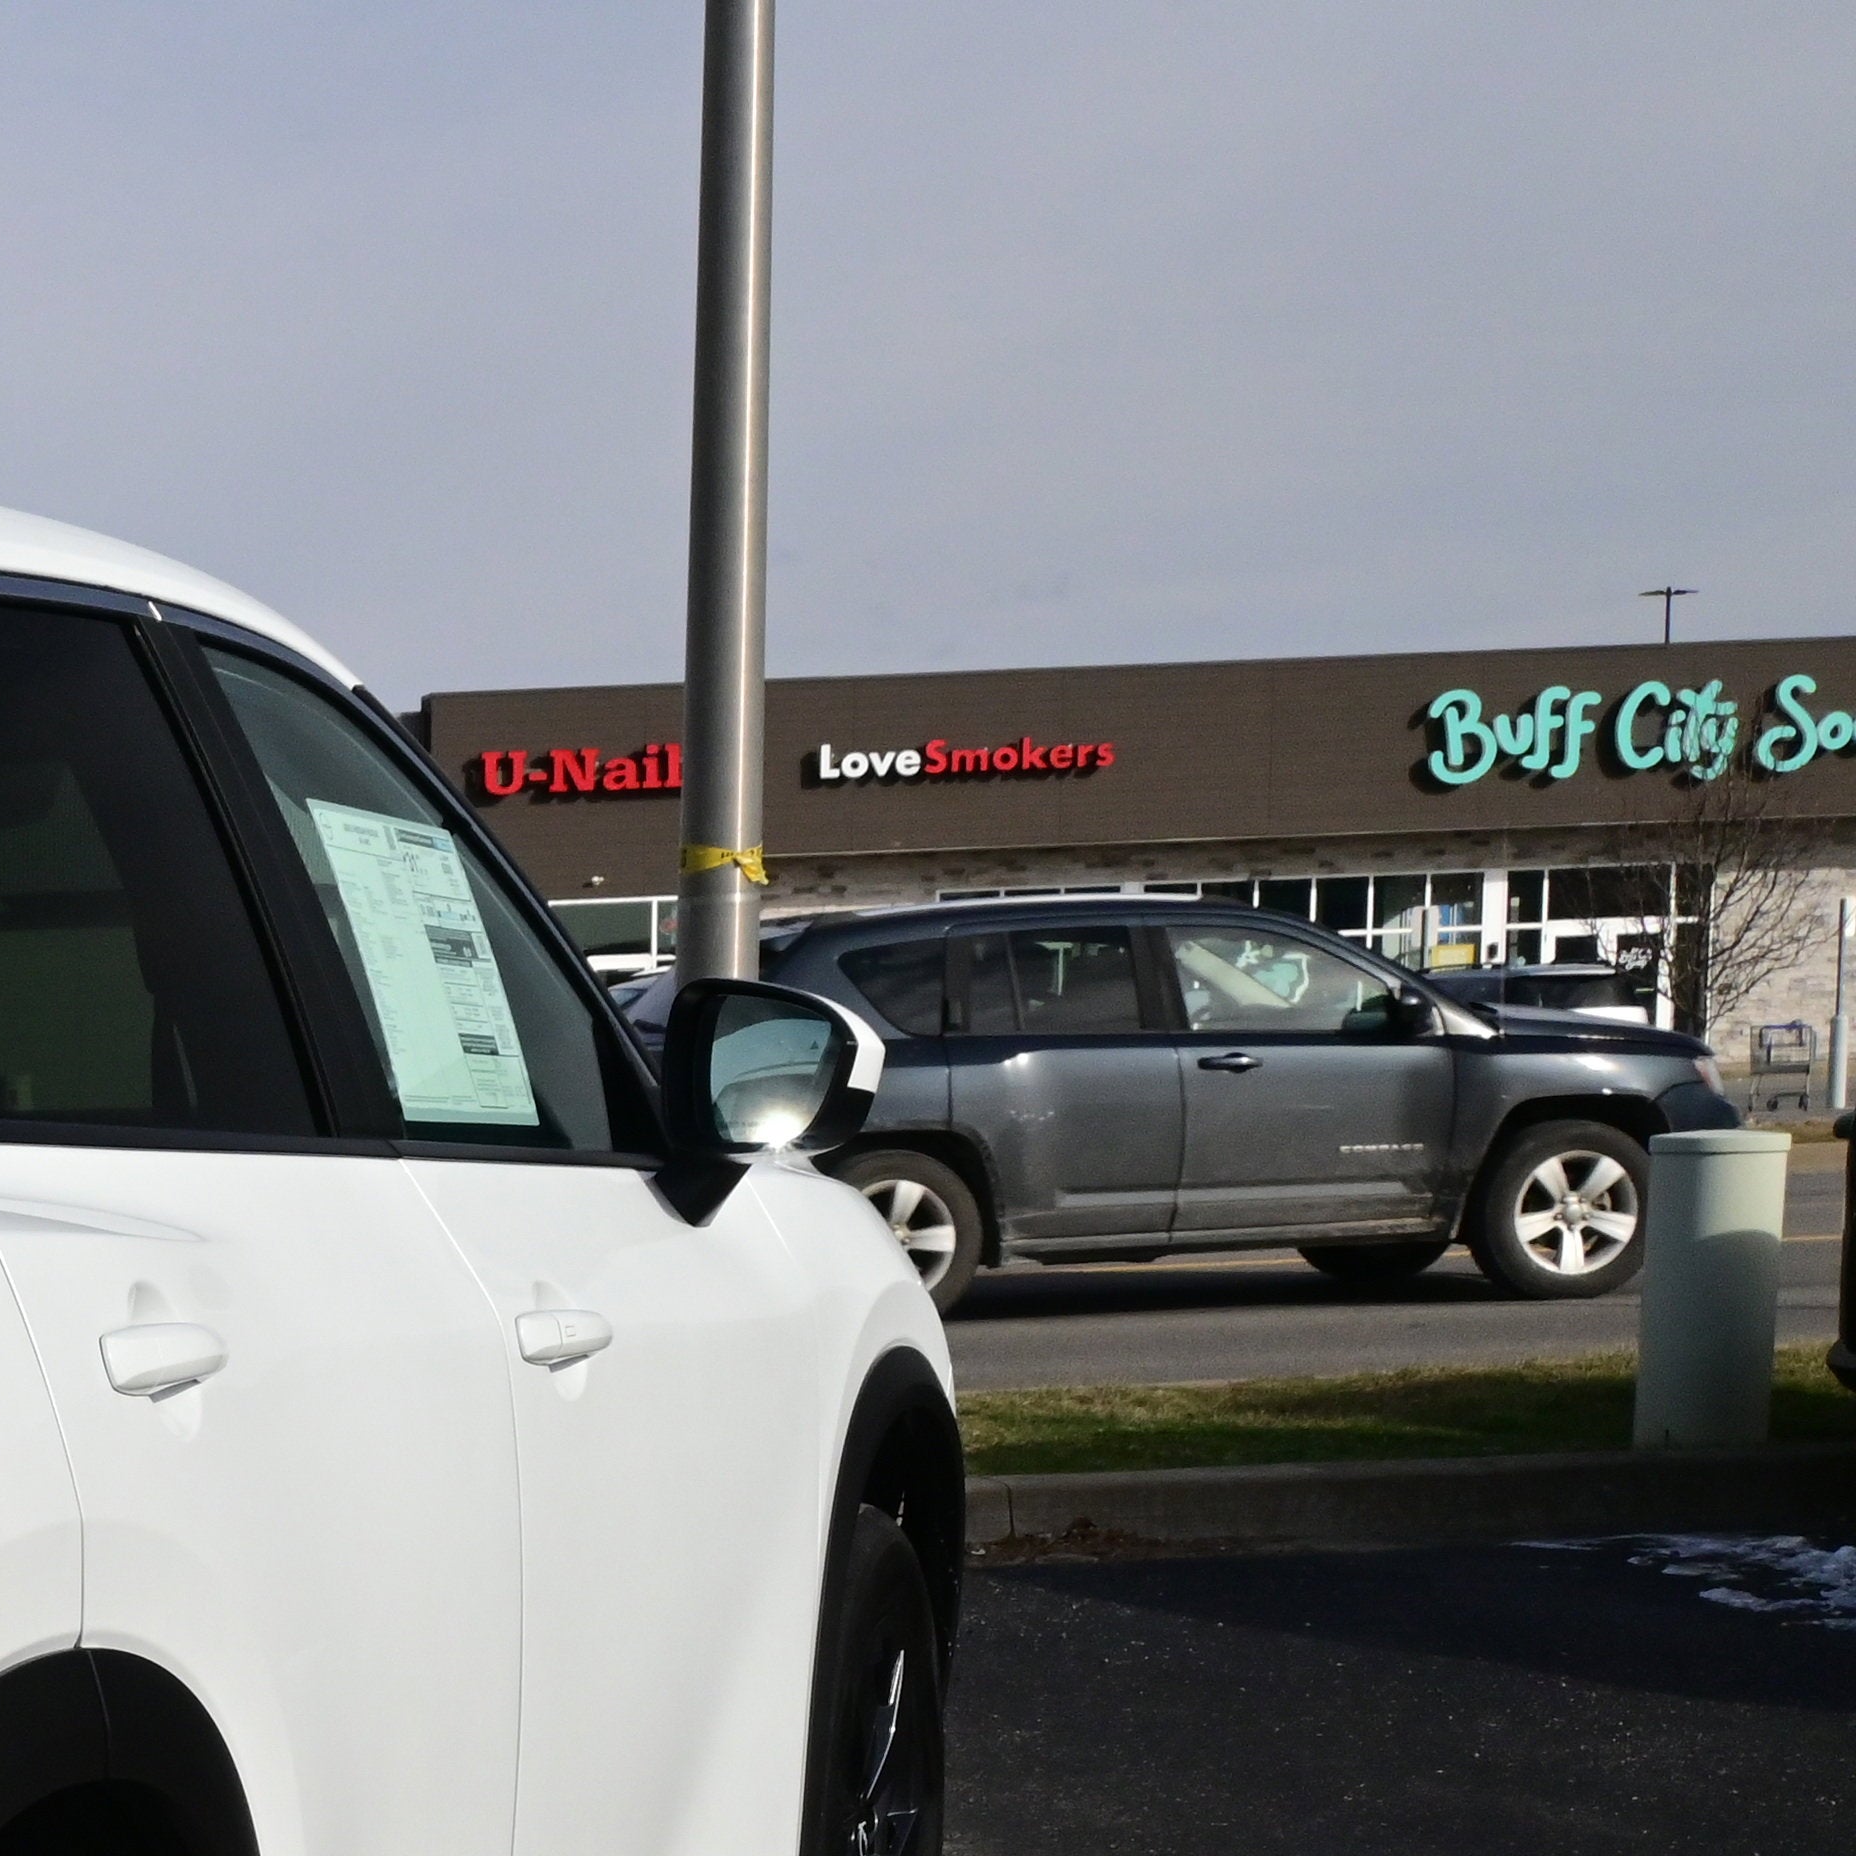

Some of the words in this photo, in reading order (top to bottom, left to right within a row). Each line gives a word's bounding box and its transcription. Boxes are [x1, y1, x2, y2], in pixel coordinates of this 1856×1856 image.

[1429, 685, 1602, 785] Buff
[1615, 679, 1739, 781] City
[1754, 674, 1856, 773] So
